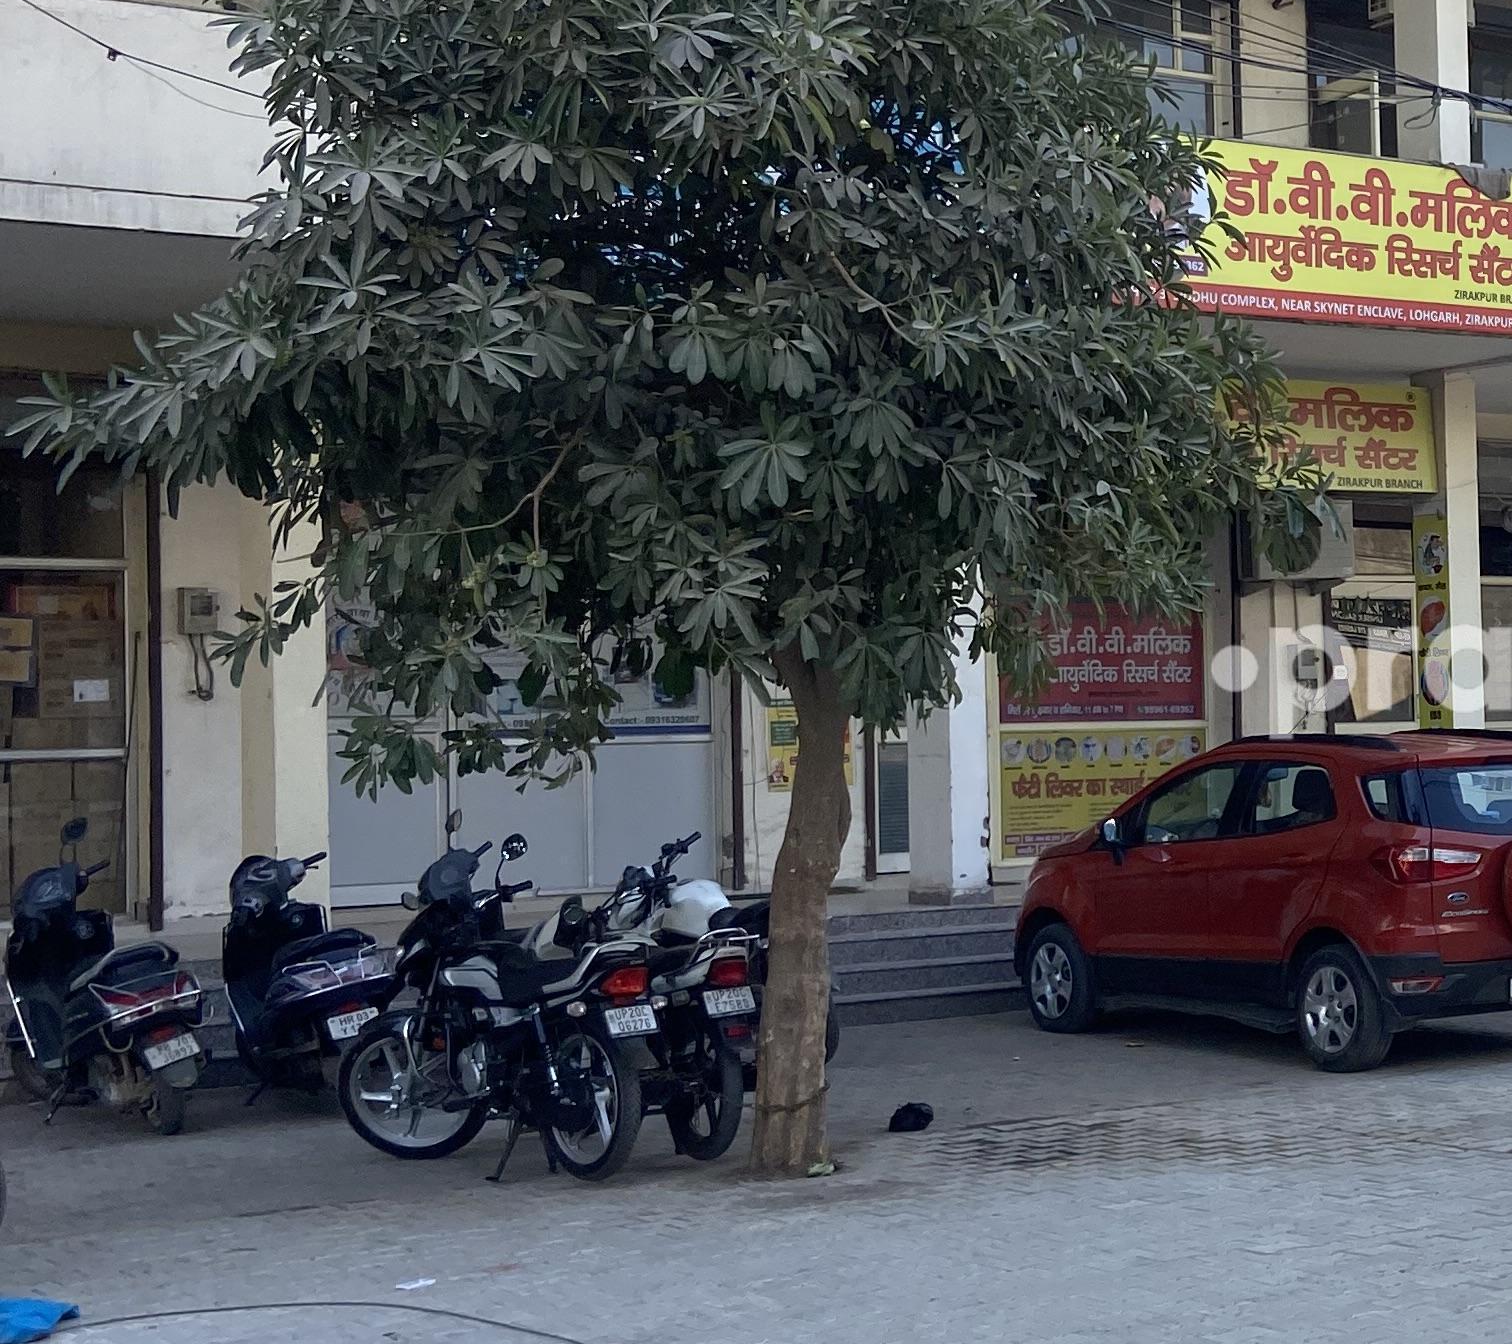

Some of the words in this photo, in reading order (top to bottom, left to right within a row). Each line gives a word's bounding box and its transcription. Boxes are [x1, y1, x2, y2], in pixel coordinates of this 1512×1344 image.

[1385, 234, 1463, 283] रिसर्च
[1454, 289, 1498, 304] ZIRAKPUR
[1220, 293, 1279, 312] COMPLEX,
[1281, 297, 1312, 313] NEAR
[1314, 300, 1355, 316] SKYNET
[1357, 302, 1407, 322] ENCLAVE,
[1409, 307, 1462, 327] LOHGARH,
[1337, 476, 1384, 488] ZIRAKPUR
[1385, 478, 1424, 489] BRANCH
[614, 1006, 648, 1021] UP20C
